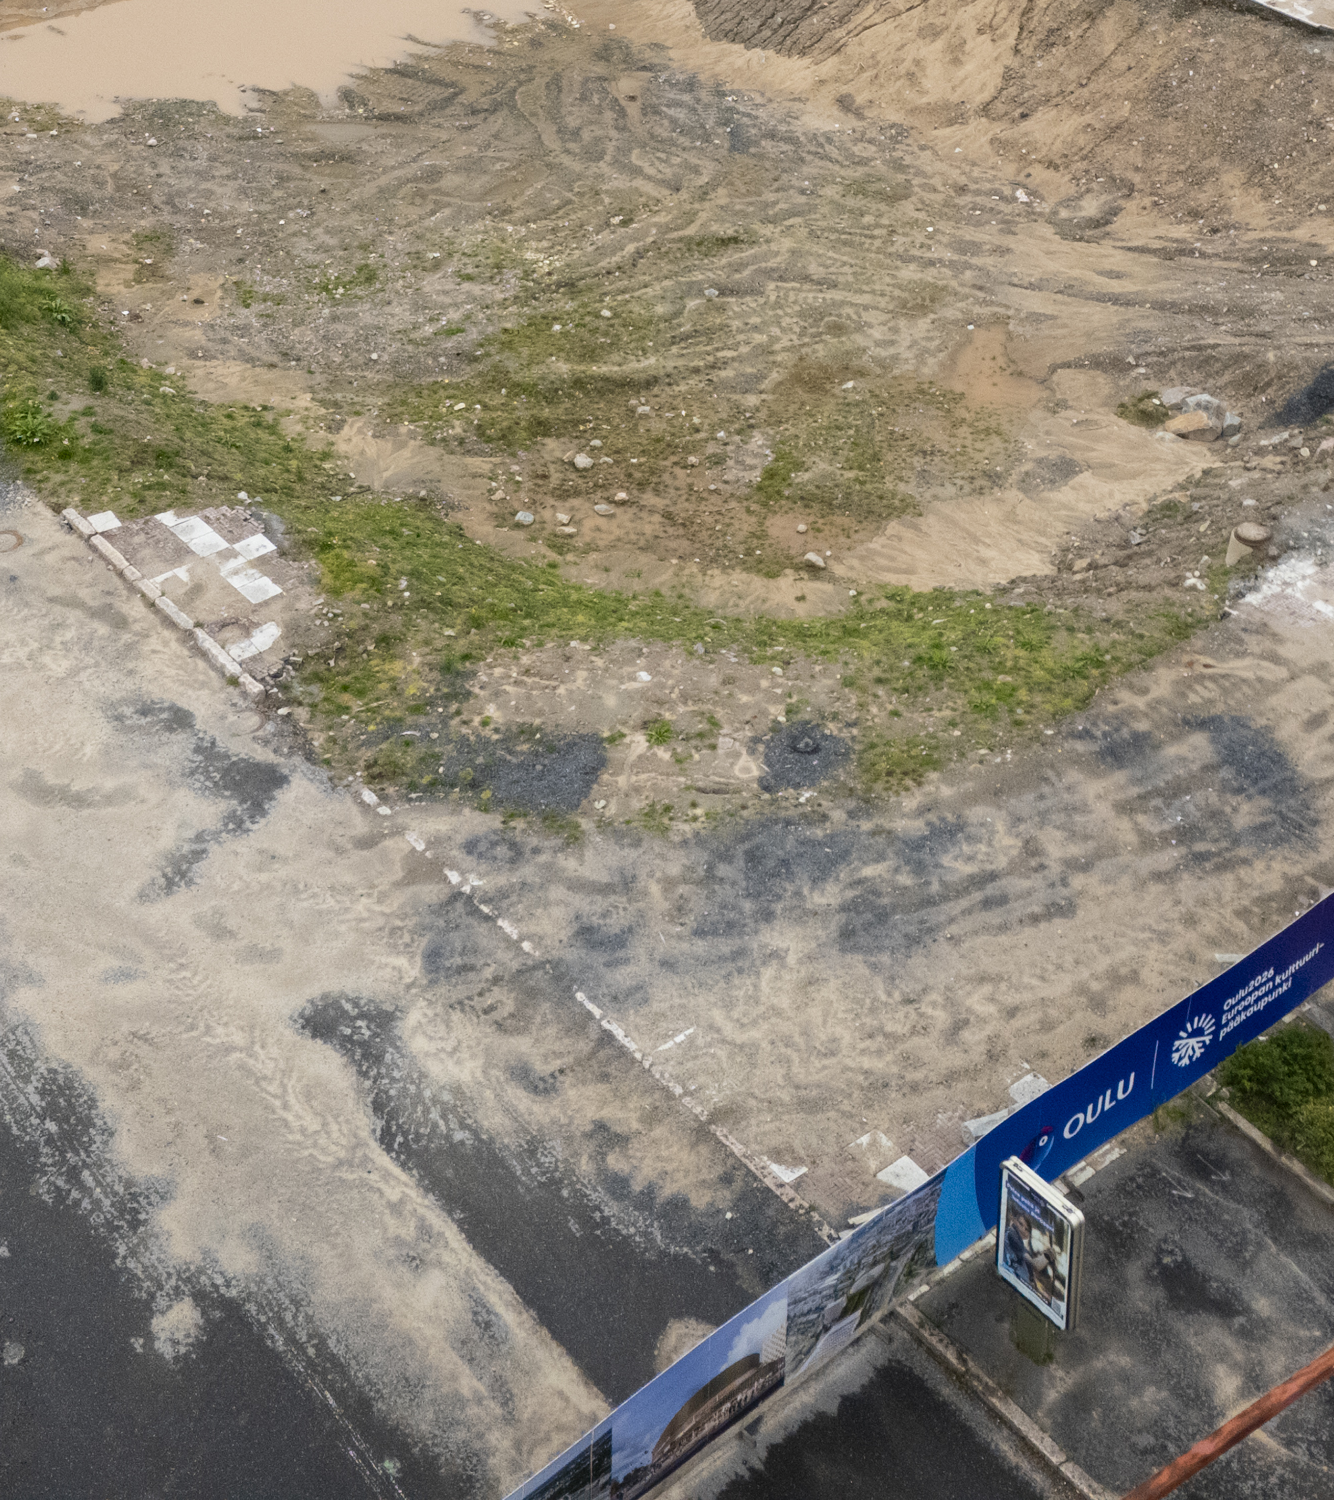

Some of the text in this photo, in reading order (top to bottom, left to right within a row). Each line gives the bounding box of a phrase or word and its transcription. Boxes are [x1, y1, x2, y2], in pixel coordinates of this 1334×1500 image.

[1219, 976, 1293, 1041] pääkaupunki
[1221, 941, 1325, 1025] Euroopan kulttuuri-
[1223, 966, 1275, 1011] Oulu2026
[1063, 1071, 1136, 1140] OULU
